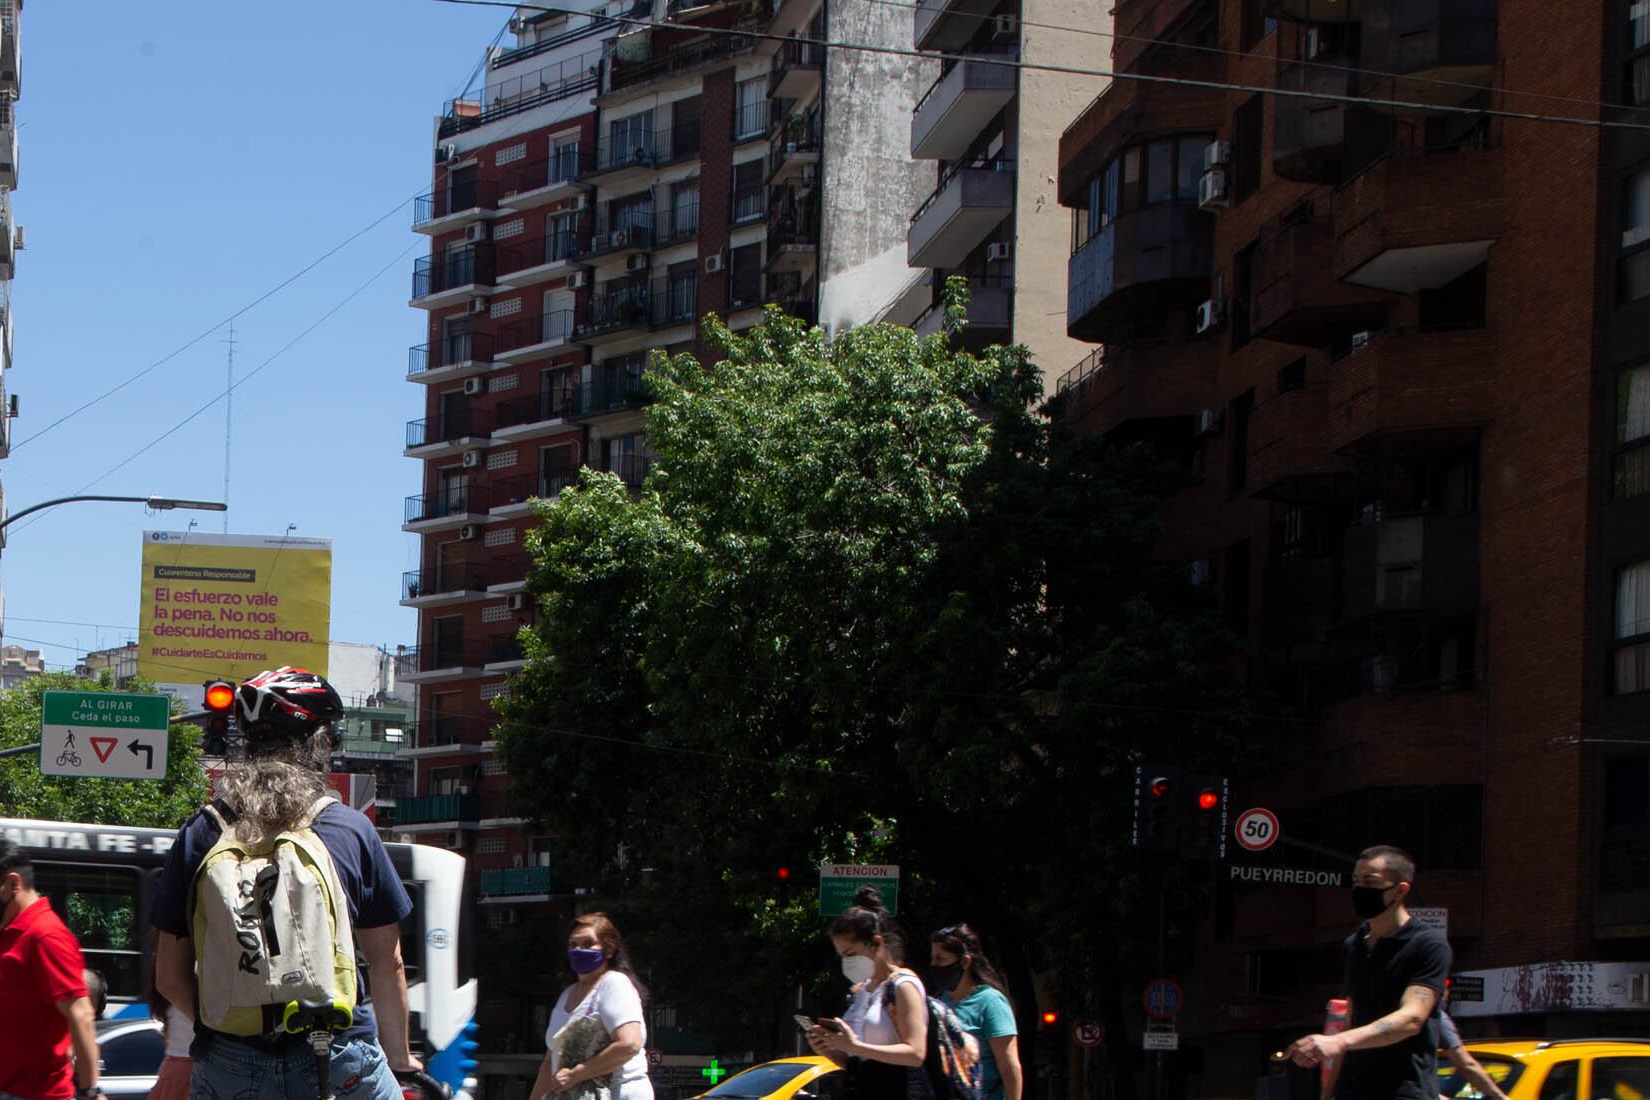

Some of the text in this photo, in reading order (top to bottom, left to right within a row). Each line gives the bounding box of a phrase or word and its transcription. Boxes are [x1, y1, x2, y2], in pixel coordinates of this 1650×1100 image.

[158, 568, 251, 579] Cuarentena Responsable
[154, 588, 279, 606] El esfuerzo vale
[154, 606, 276, 624] la pena. No nos
[153, 624, 313, 643] descuidemos ahora.
[80, 699, 133, 710] AL GIRAR
[72, 711, 141, 723] Ceda el paso
[1244, 820, 1269, 839] 50
[98, 833, 137, 853] FE
[832, 866, 887, 876] ATENCION
[1230, 866, 1342, 887] PUEYRREDON
